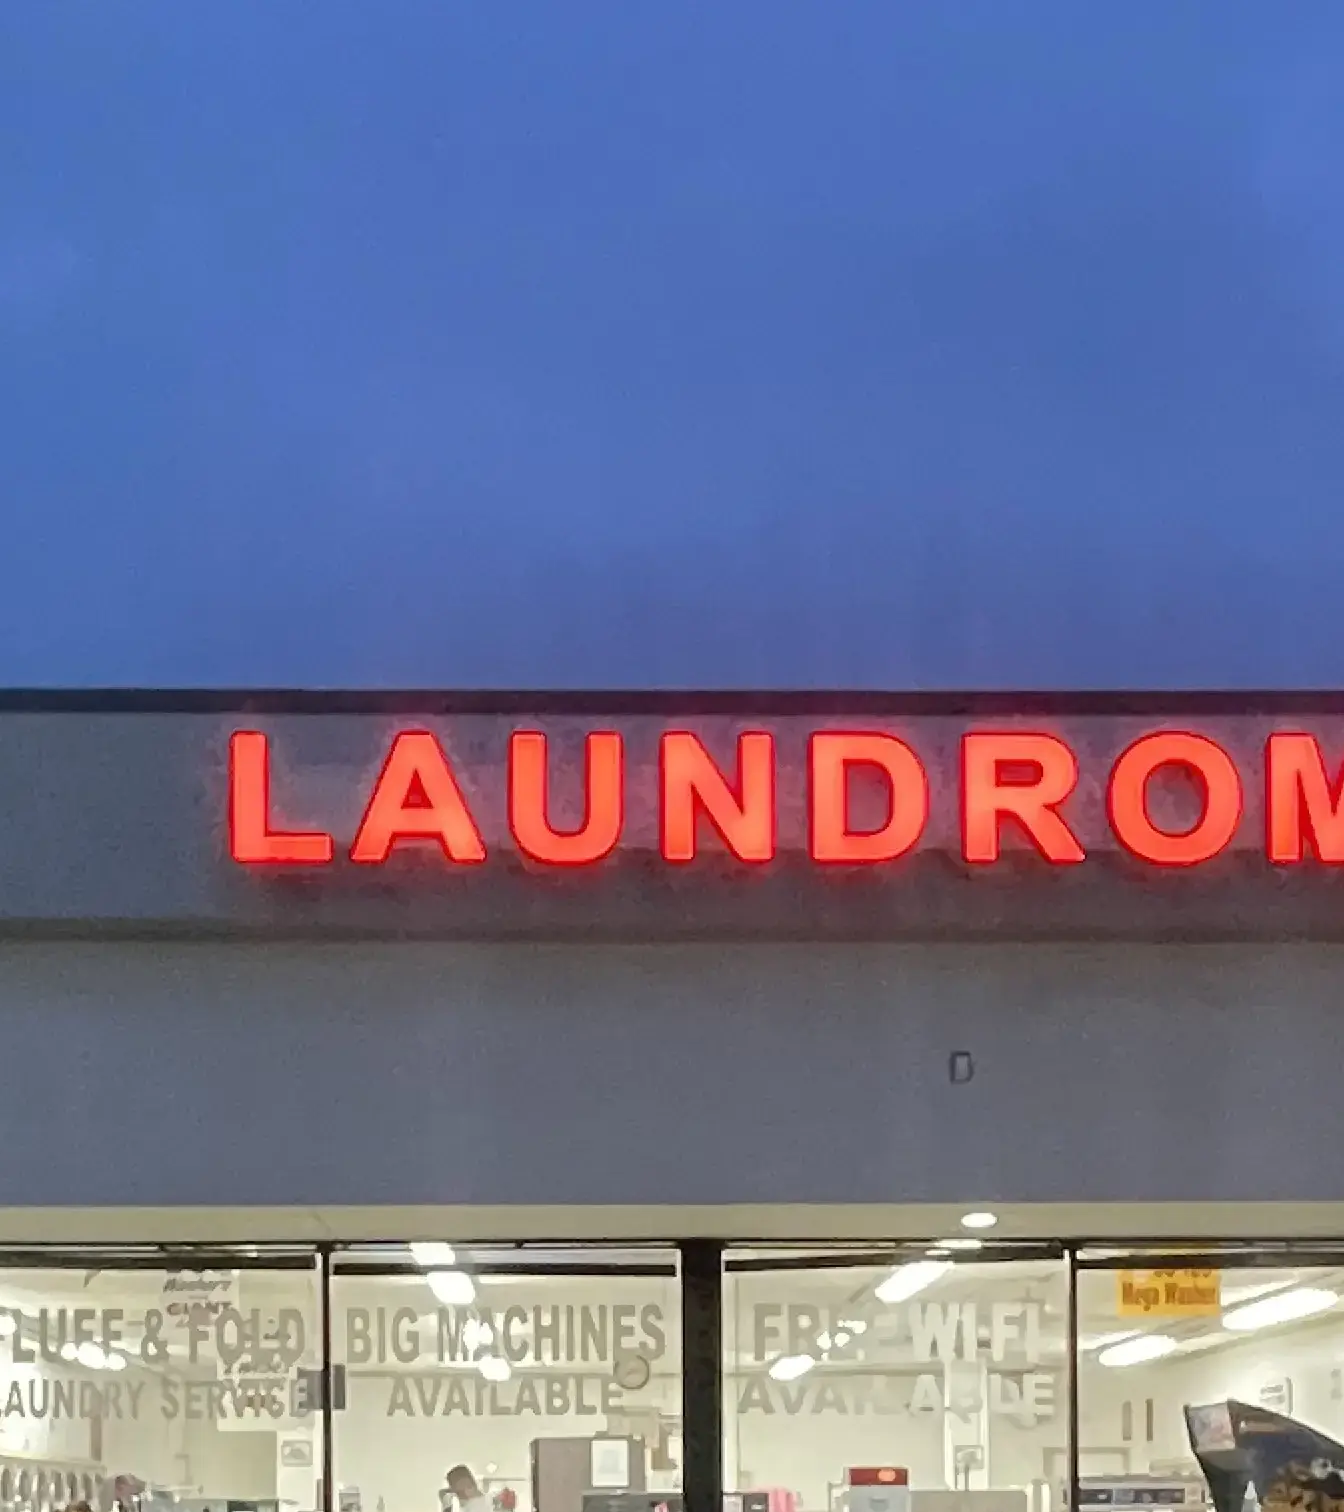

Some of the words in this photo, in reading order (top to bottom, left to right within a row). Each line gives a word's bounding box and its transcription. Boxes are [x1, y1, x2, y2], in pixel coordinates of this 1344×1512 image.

[140, 1309, 170, 1364] &
[188, 1307, 305, 1366] FOLD
[346, 1306, 420, 1364] BIG
[435, 1304, 666, 1363] MACHINES
[160, 1377, 313, 1420] SERVICE
[386, 1374, 626, 1417] AVAILABLE
